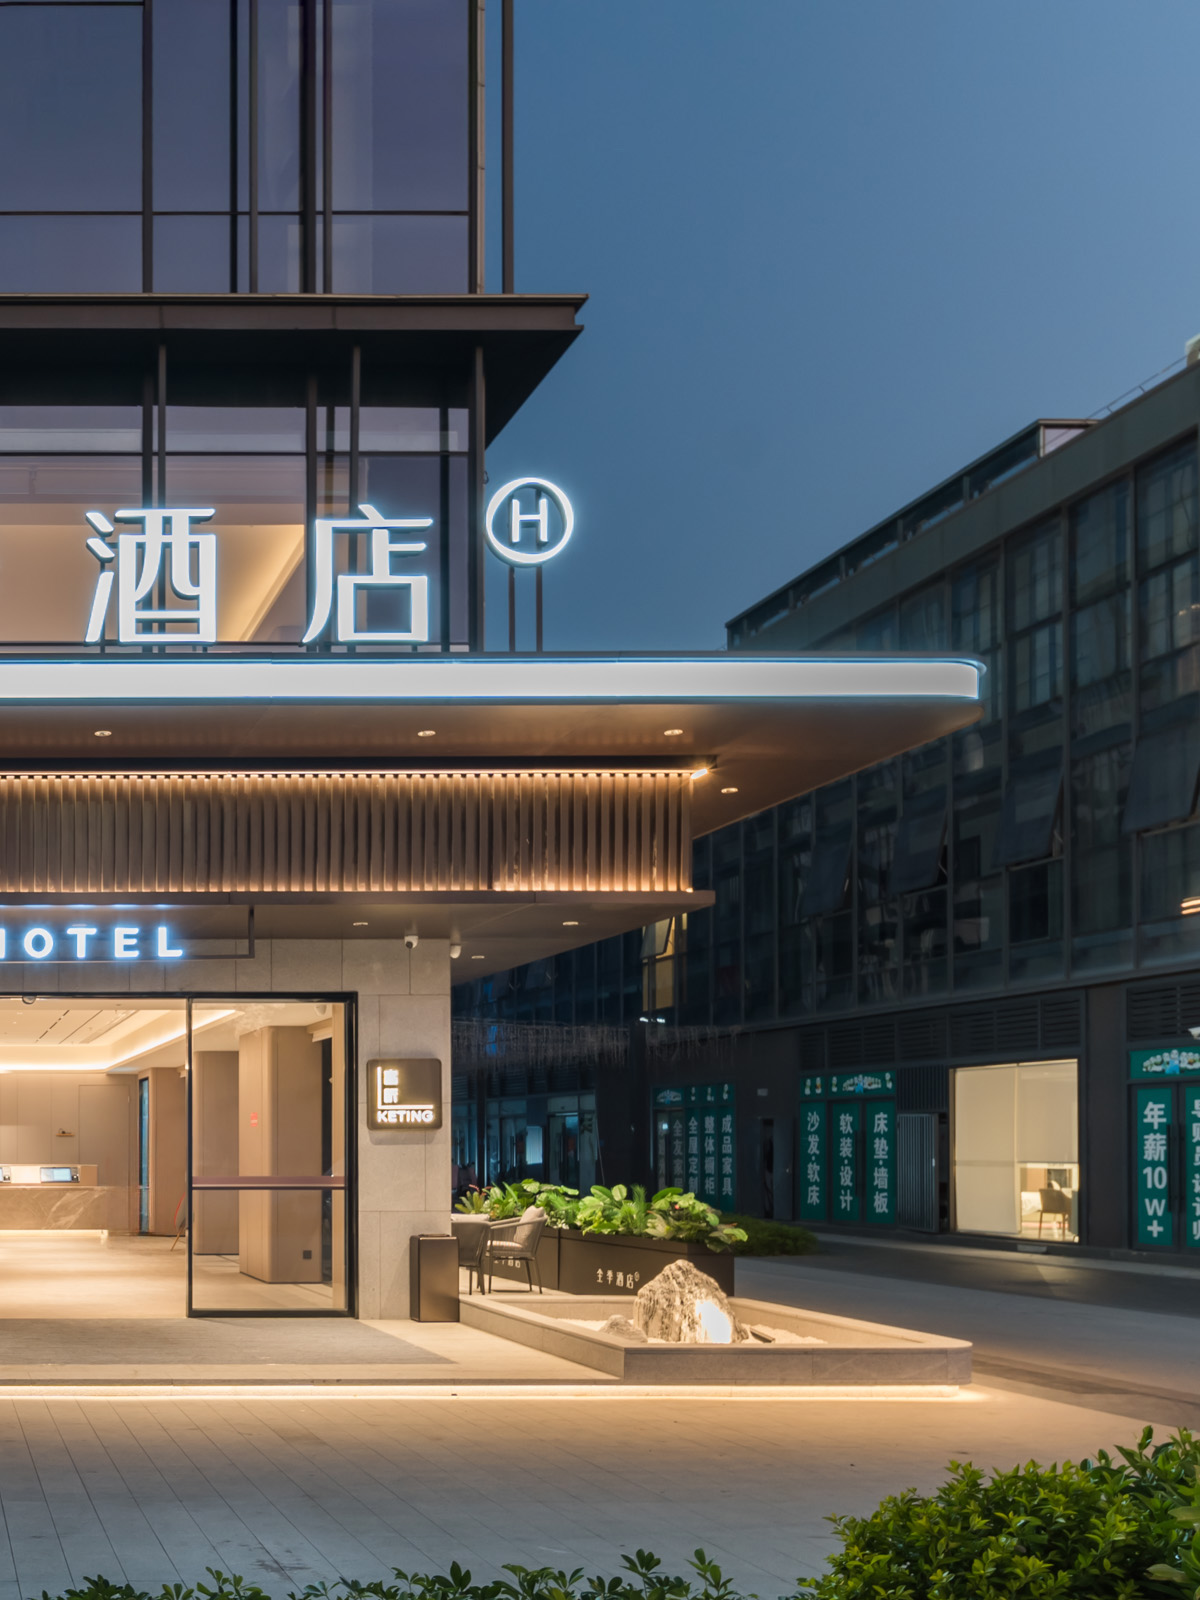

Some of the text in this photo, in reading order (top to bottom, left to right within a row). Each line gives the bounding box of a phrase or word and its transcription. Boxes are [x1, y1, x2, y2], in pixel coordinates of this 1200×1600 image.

[377, 1110, 434, 1123] KETING
[688, 1116, 698, 1194] 全屋定制
[721, 1114, 732, 1196] 成品家具
[1142, 1101, 1167, 1239] 年薪10W+
